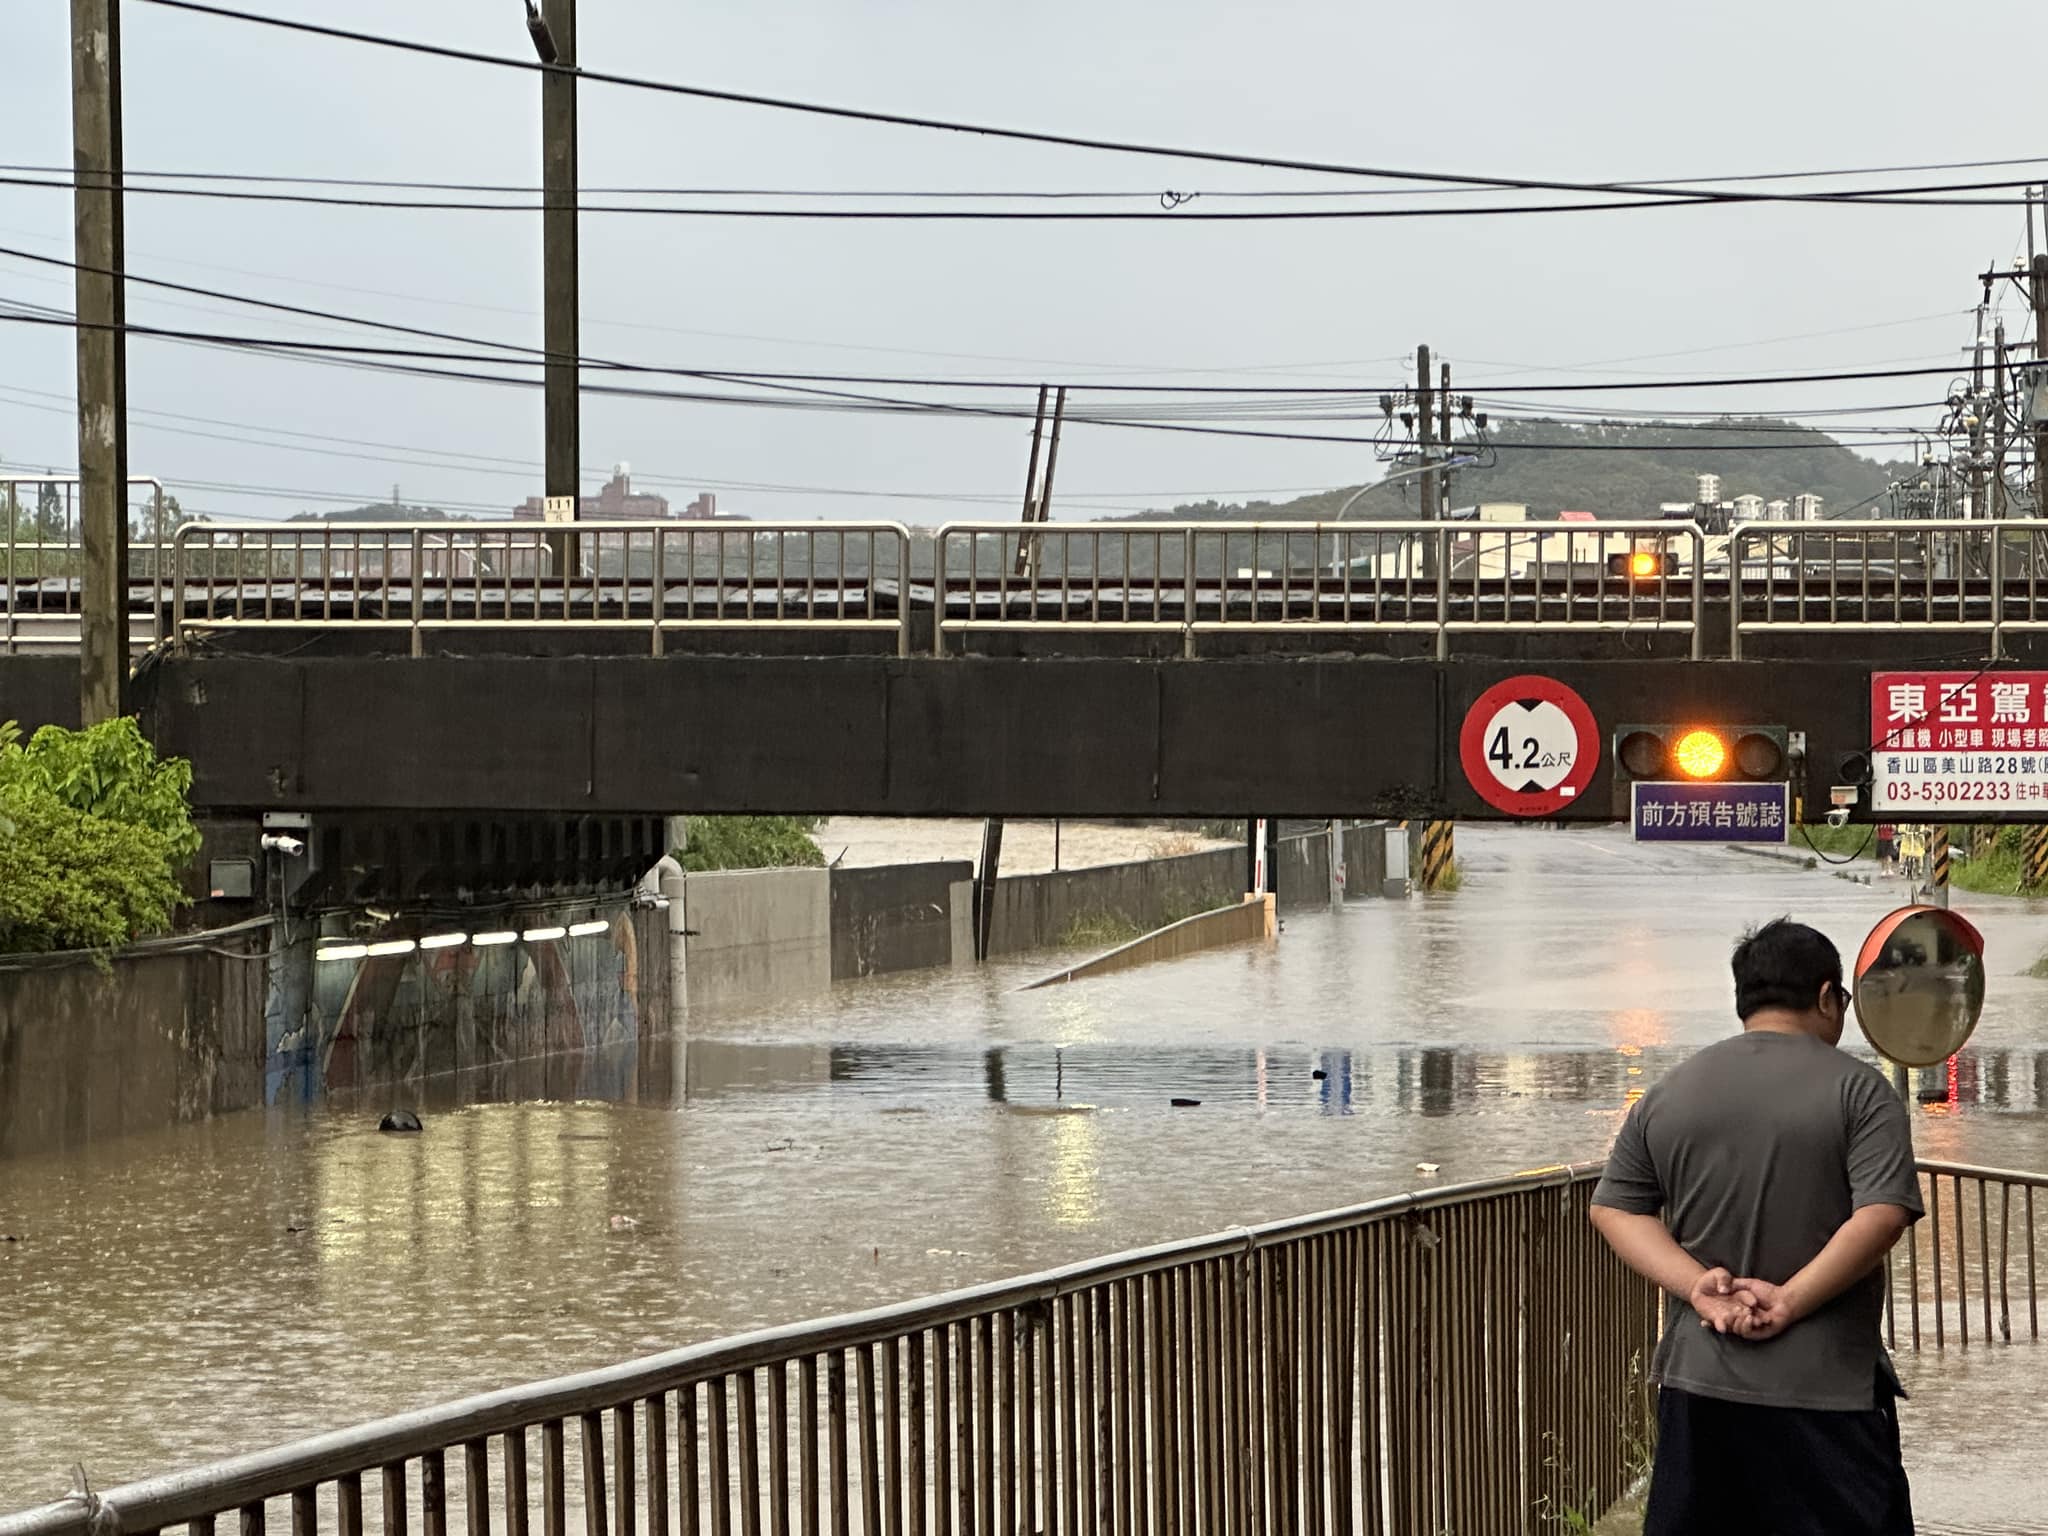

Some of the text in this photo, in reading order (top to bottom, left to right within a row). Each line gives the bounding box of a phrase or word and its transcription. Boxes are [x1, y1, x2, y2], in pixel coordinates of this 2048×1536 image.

[1888, 682, 2048, 723] 東亞駕
[1939, 729, 1984, 748] 小型車
[1888, 756, 2048, 774] 香山區美山路28號(
[1888, 782, 2010, 800] 03-5302233
[1642, 801, 1781, 827] 前方預告號誌
